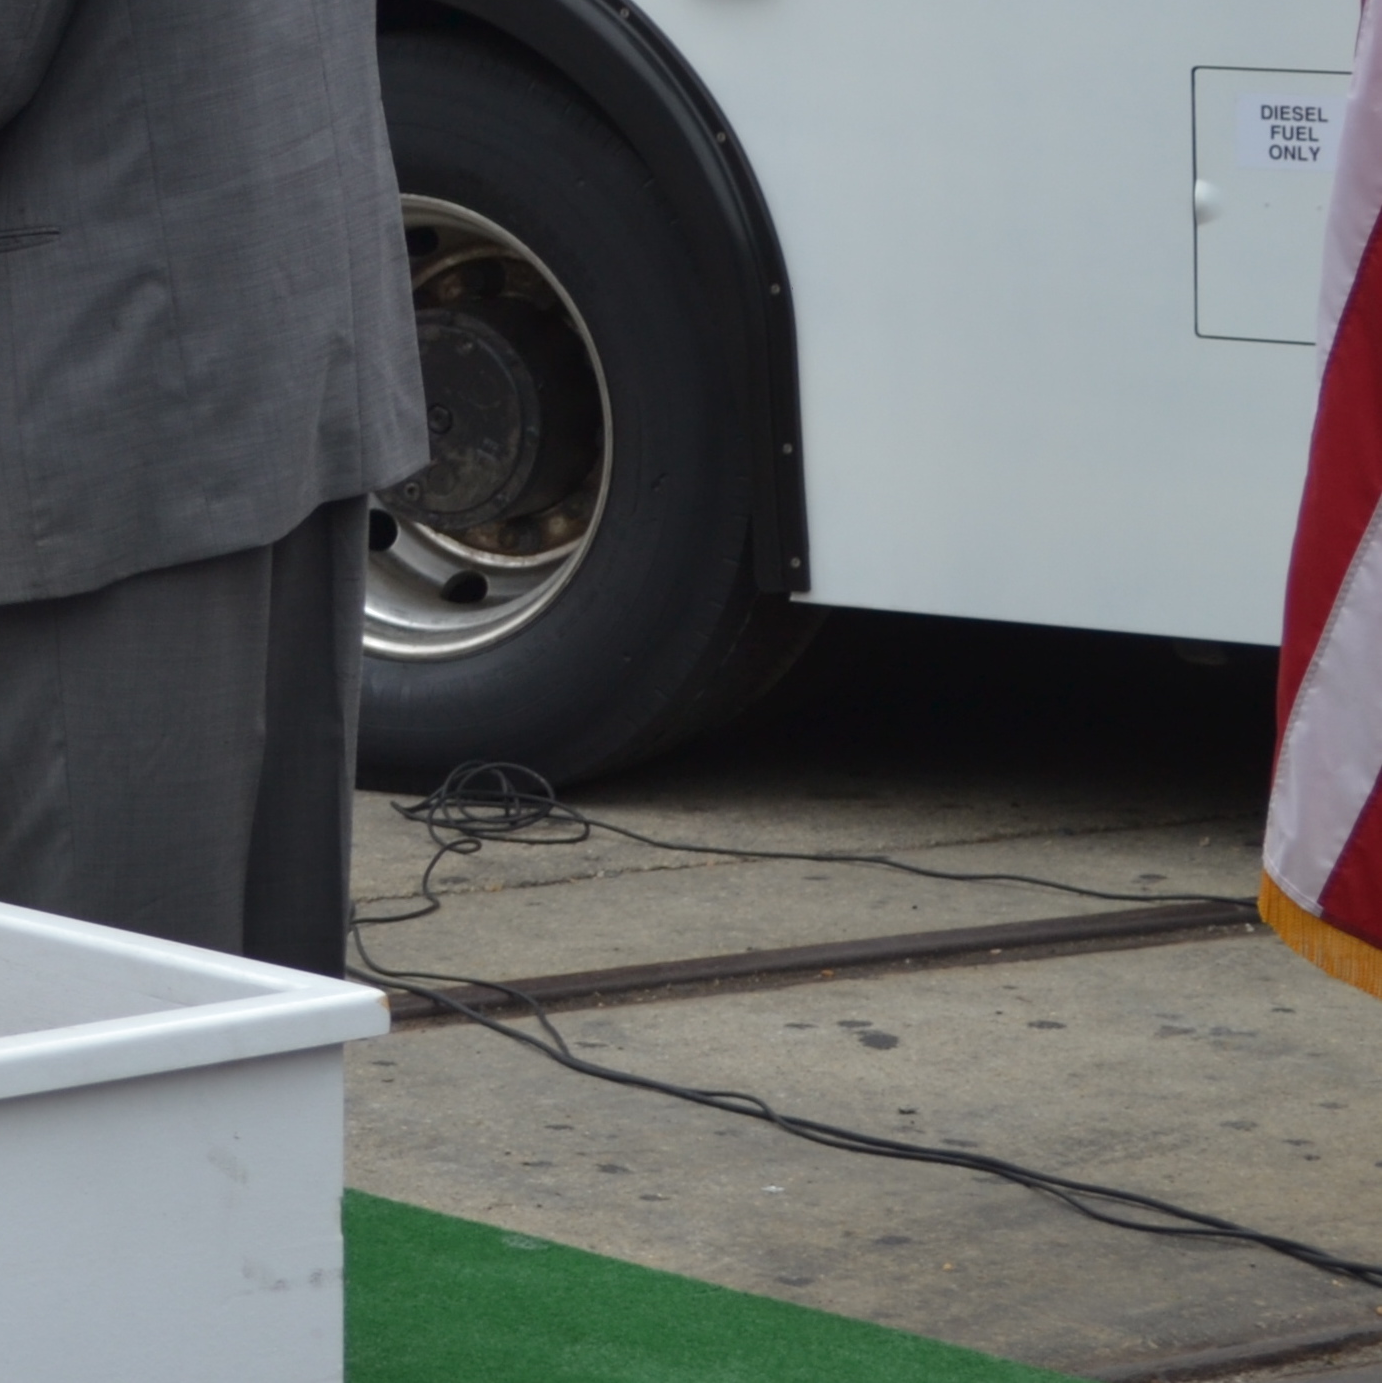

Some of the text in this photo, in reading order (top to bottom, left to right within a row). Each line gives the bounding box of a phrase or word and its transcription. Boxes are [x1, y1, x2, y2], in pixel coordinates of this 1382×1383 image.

[1260, 104, 1329, 123] DIESEL
[1270, 125, 1319, 142] FUEL
[1268, 144, 1321, 162] ONLY
